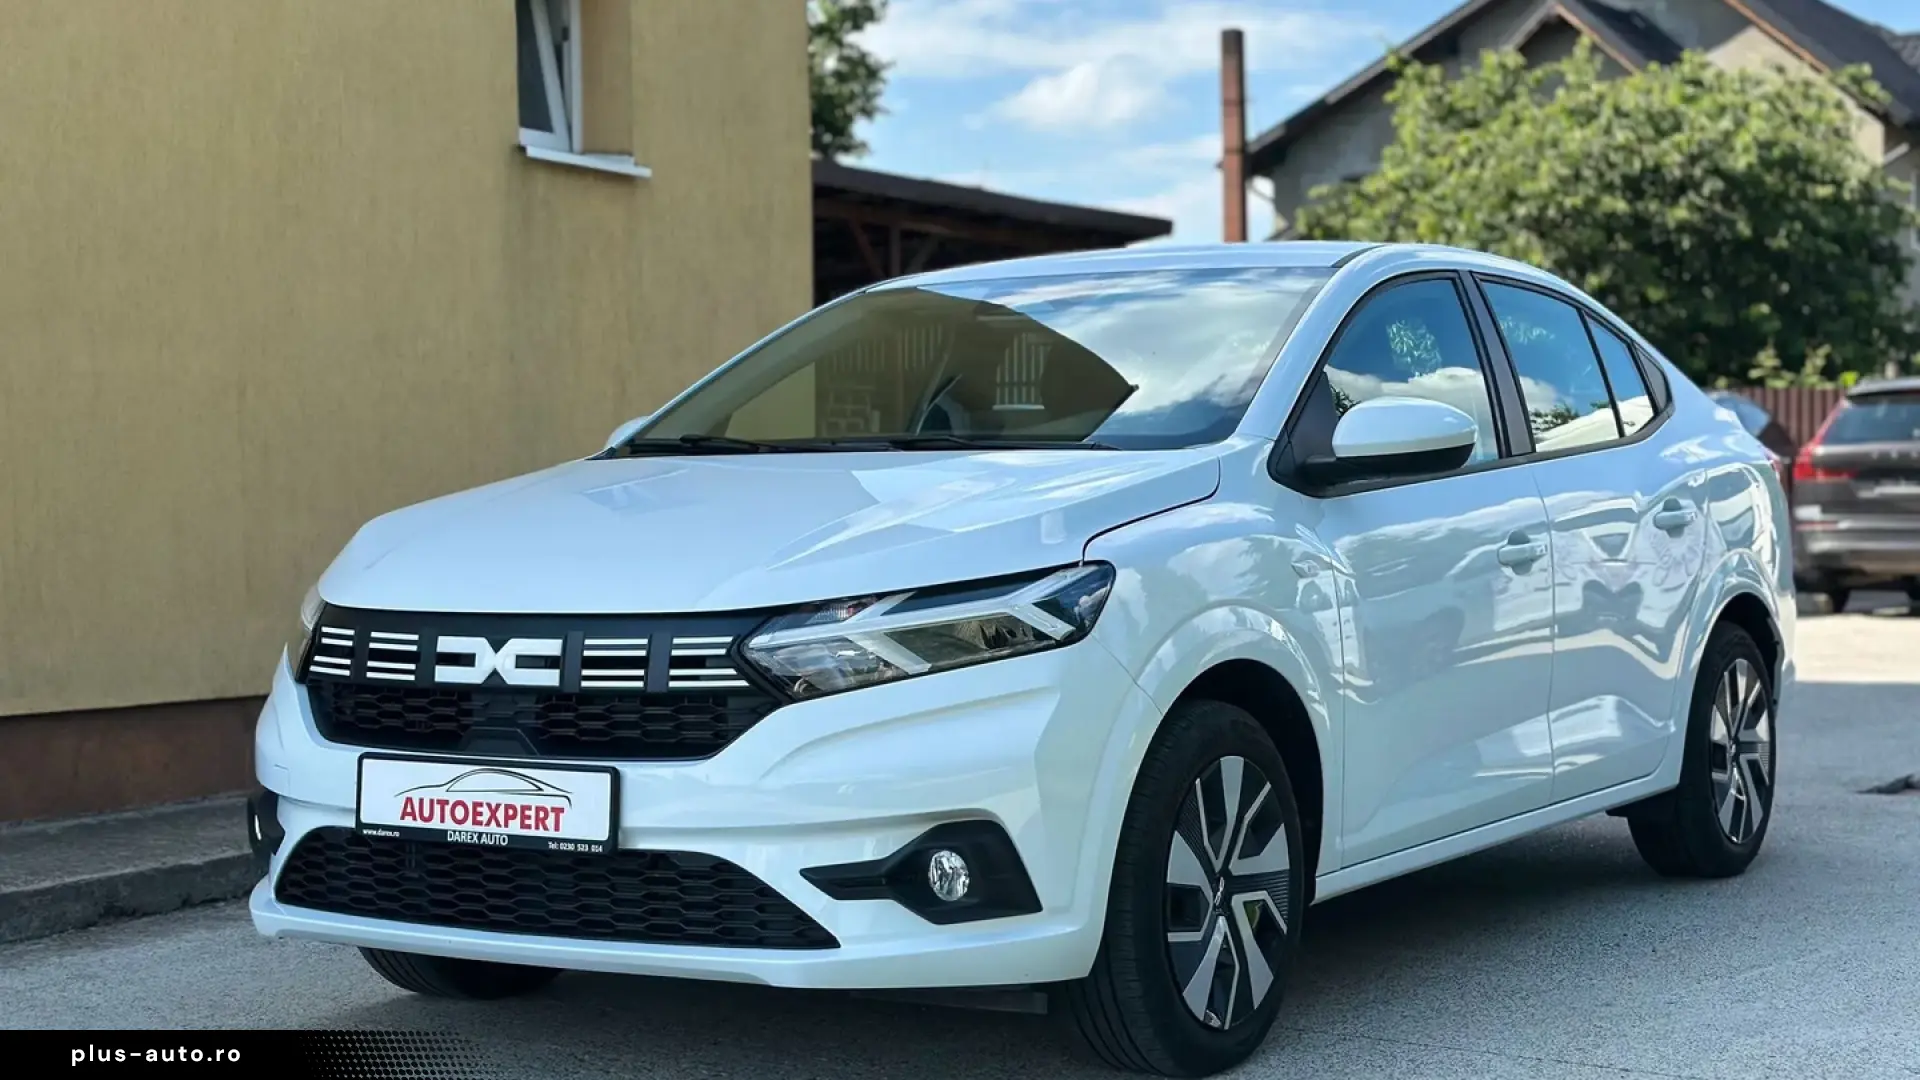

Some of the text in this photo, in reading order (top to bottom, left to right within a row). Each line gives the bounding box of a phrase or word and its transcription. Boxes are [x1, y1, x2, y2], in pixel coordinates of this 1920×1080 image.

[399, 796, 565, 832] AUTOEXPERT
[362, 828, 400, 837] www.darex.ro
[447, 830, 508, 846] DAREX AUTO
[548, 841, 559, 850] Tel:
[560, 842, 575, 851] 0230
[577, 843, 589, 852] 523
